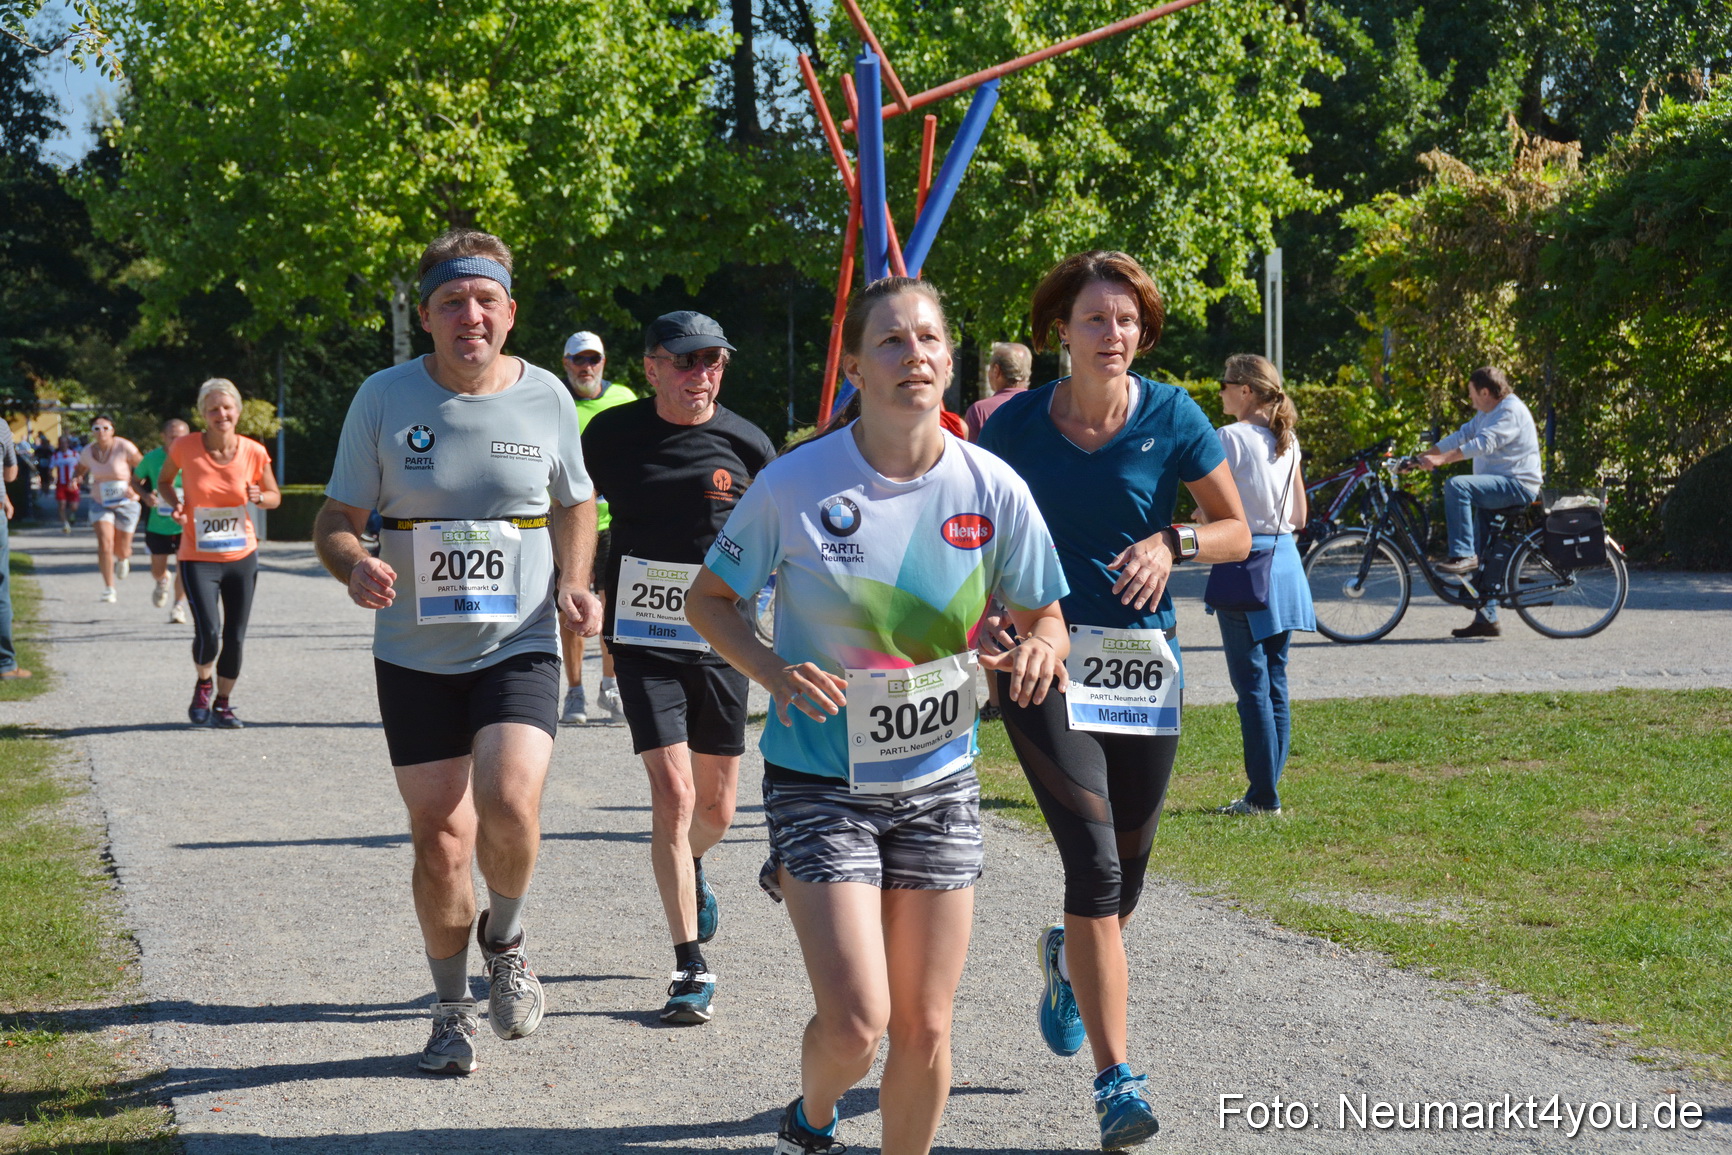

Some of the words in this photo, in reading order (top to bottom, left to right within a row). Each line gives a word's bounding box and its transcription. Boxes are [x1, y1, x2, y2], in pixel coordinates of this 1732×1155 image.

[491, 441, 542, 458] BOCK
[203, 518, 239, 534] 2007
[949, 523, 988, 540] Hervis
[442, 531, 490, 542] BOCK
[716, 530, 744, 562] OCK
[821, 543, 863, 554] PARTL
[430, 550, 504, 581] 2026
[821, 554, 864, 563] Neumarkt
[647, 568, 689, 580] BOCK
[455, 599, 480, 611] Max
[649, 625, 677, 637] Hans
[1102, 638, 1151, 650] BOCK
[888, 670, 943, 693] BOCK
[1083, 657, 1163, 690] 2366
[870, 690, 958, 743] 3020
[1098, 708, 1148, 723] Martina
[880, 745, 908, 756] PARTL
[910, 735, 943, 751] Neumarkt
